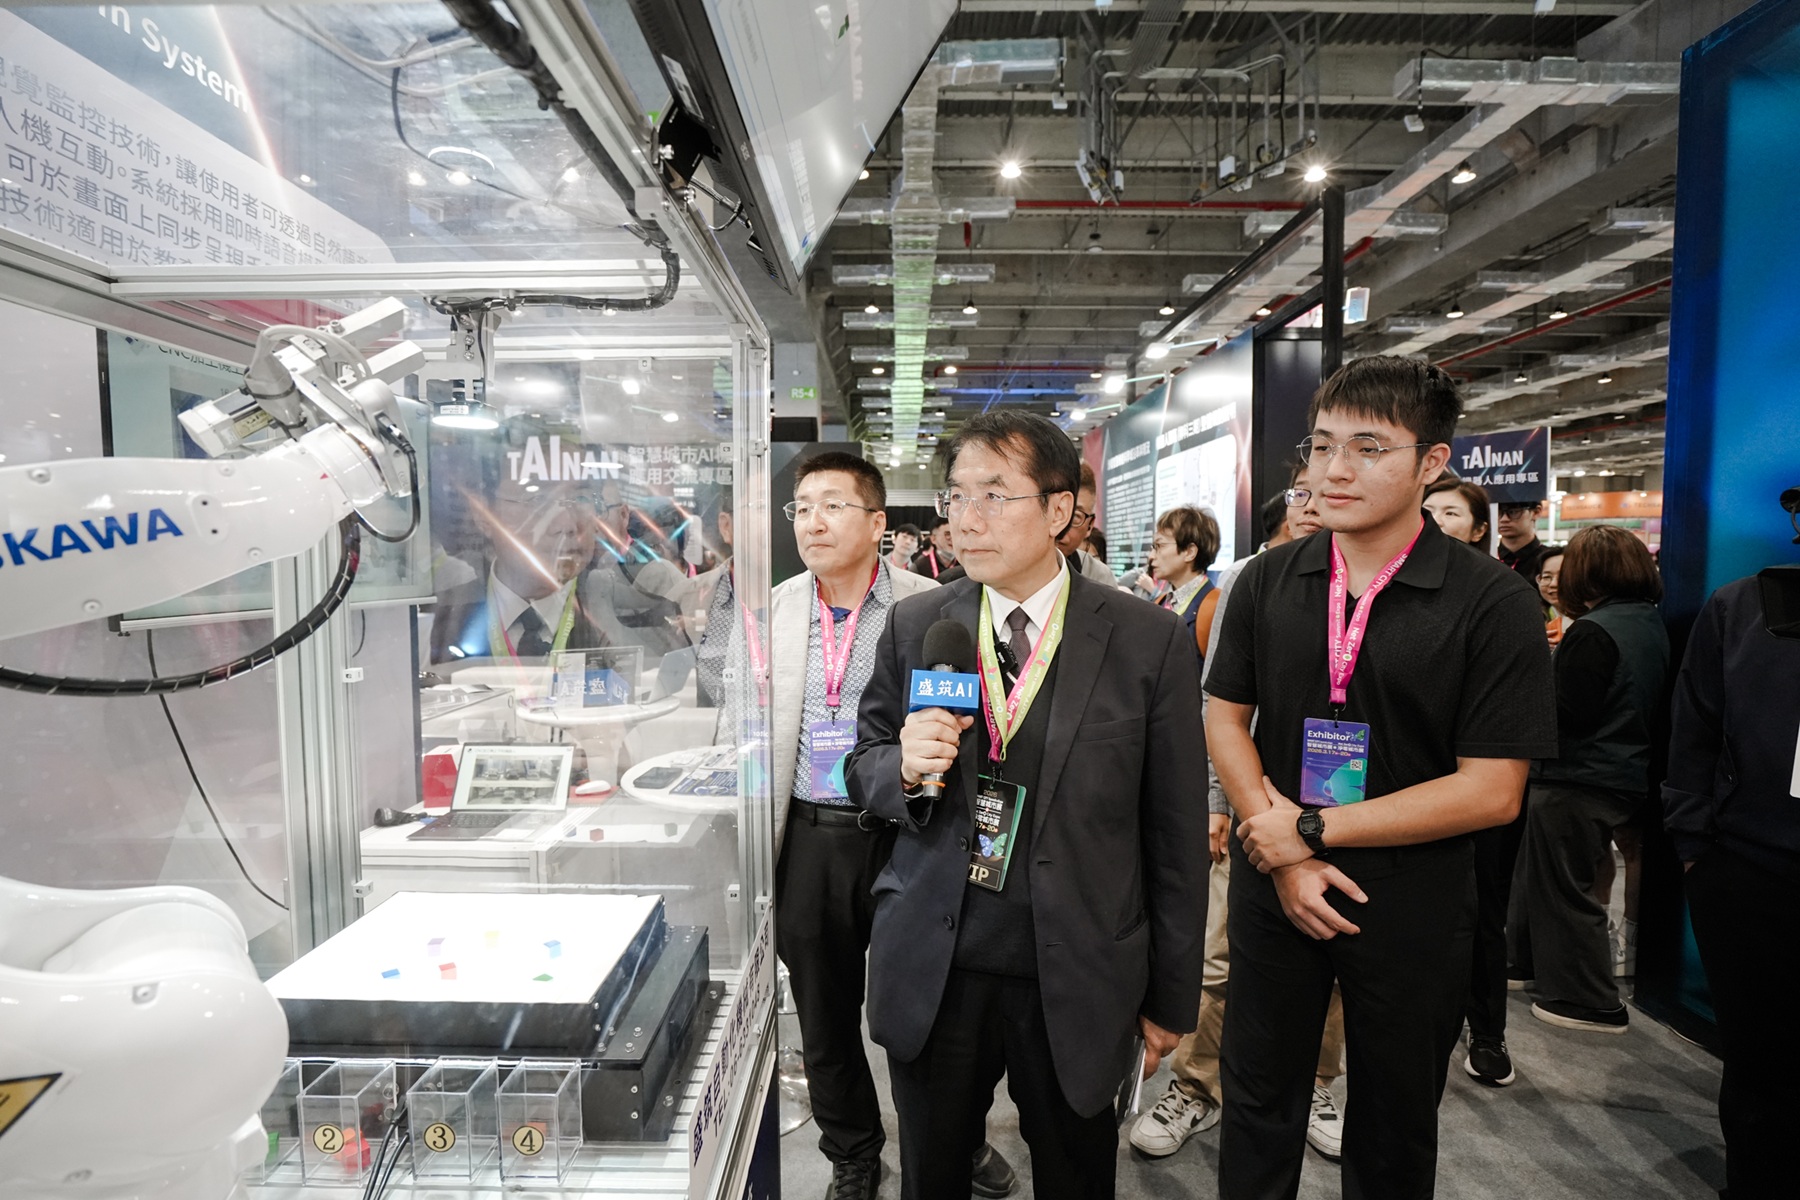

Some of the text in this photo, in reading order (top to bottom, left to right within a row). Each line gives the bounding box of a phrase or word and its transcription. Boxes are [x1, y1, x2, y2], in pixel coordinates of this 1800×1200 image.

[141, 17, 250, 114] System
[506, 435, 620, 482] TAINAN
[1461, 445, 1524, 470] TAINAN
[0, 508, 184, 569] KAWA
[1385, 553, 1408, 577] SMART
[1334, 586, 1342, 598] Net
[1372, 574, 1389, 590] CITY
[1348, 626, 1361, 641] Net
[916, 678, 973, 698] 盛筑AI
[1307, 730, 1351, 742] Exhibitor
[969, 863, 990, 882] IP
